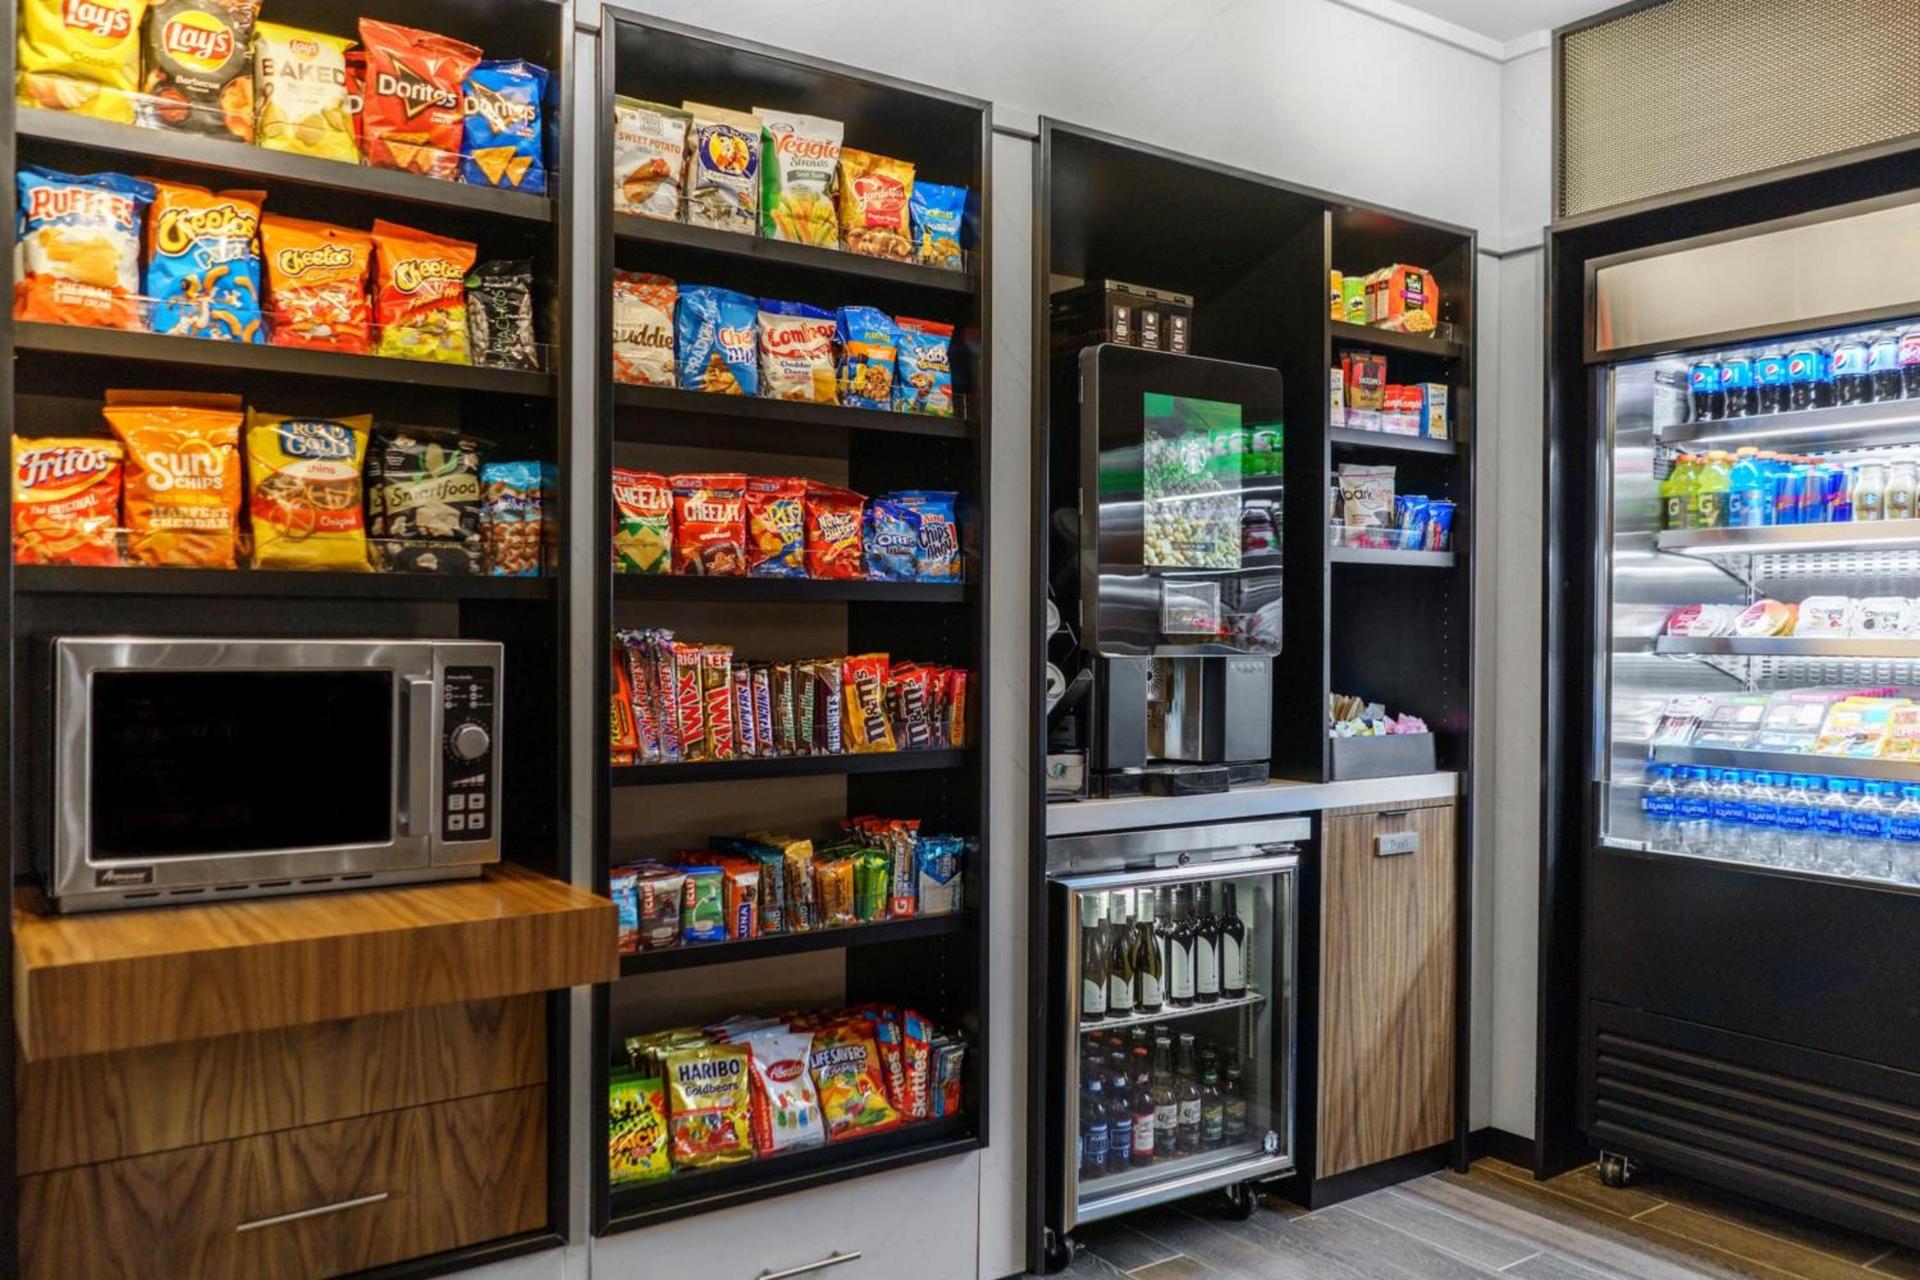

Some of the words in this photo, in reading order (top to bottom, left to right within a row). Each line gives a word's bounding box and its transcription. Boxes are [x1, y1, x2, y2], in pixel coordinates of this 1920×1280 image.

[64, 0, 130, 37] Lay's
[168, 22, 230, 59] Lay's
[262, 58, 346, 86] BAKED
[378, 73, 457, 108] Doritos
[464, 95, 536, 121] Doritos
[618, 132, 647, 145] SWEET
[650, 137, 681, 154] POTATO
[772, 132, 840, 159] Veggie
[30, 188, 132, 227] RUFFLES
[158, 204, 257, 255] Cheetos
[279, 245, 352, 276] Cheetos
[394, 259, 463, 292] Cheetos
[286, 435, 351, 456] GOLD
[17, 449, 109, 488] Fritos
[146, 446, 227, 490] Sun
[175, 476, 223, 490] CHIPS
[388, 479, 477, 508] Smartfood
[151, 507, 229, 520] HARVEST
[1668, 498, 1680, 515] G
[1700, 495, 1713, 513] G
[1729, 493, 1742, 512] G
[150, 517, 229, 529] CHEDDAR
[920, 524, 949, 550] Chips
[679, 671, 704, 745] TWIX
[756, 685, 771, 742] SNICKERS
[706, 687, 733, 759] TWIX
[679, 1060, 740, 1081] HARIBO
[912, 1049, 928, 1117] Skittles
[685, 1082, 739, 1096] Goldbears
